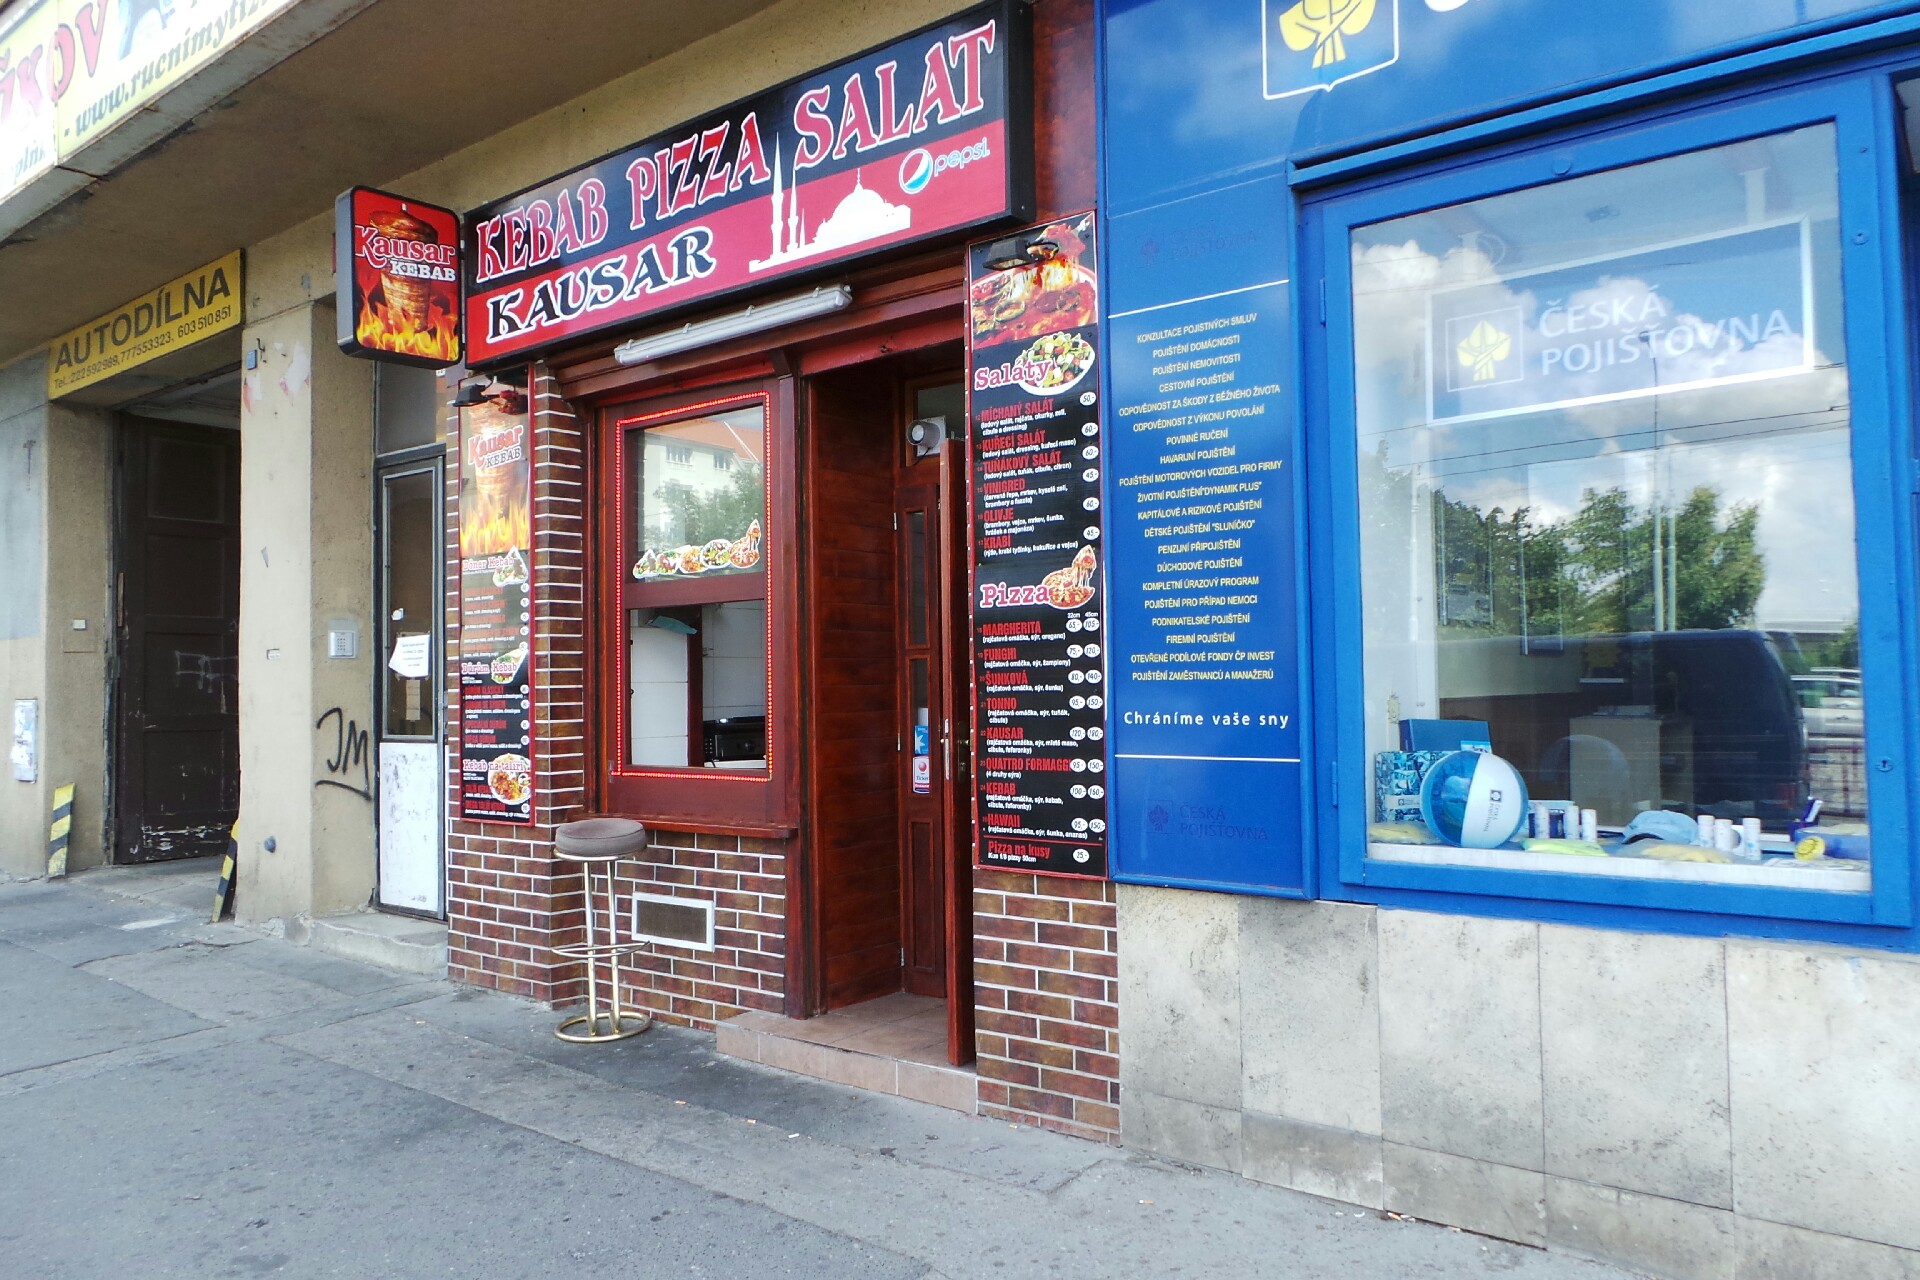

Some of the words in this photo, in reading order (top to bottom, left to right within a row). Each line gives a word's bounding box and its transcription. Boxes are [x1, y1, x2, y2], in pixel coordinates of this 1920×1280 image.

[476, 177, 607, 284] KEBAB
[626, 111, 770, 230] PIZZA
[794, 18, 995, 169] SALAT
[934, 136, 989, 177] pepsi
[355, 225, 455, 269] Kausar
[390, 260, 456, 282] KEBAB
[486, 225, 717, 343] KAUSAR
[54, 267, 231, 374] AUTODÍLNA
[1539, 285, 1667, 339] ČESKÁ
[1137, 326, 1182, 344] KONZULTACE
[1183, 318, 1230, 335] POJISTNÝCH
[1231, 312, 1258, 327] SMLUV
[1152, 342, 1189, 358] POJIŠTĚNÍ
[1190, 334, 1240, 352] DOMÁCNOSTI
[1541, 310, 1792, 376] POJIŠŤOVNA
[1152, 361, 1189, 376] POJIŠTĚNÍ
[1190, 352, 1241, 370] NEMOVITOSTI
[975, 359, 1052, 391] Saláty
[1159, 377, 1196, 393] CESTOVNÍ
[1197, 371, 1235, 387] POJIŠTĚNÍ
[981, 402, 1022, 422] MÍCHANÝ
[1025, 397, 1053, 414] SALÁT
[1119, 400, 1171, 417] ODPOVĚDNOST
[1172, 399, 1182, 410] ZA
[1183, 394, 1208, 408] ŠKODY
[1209, 394, 1215, 403] Z
[1216, 386, 1252, 402] BĚŽNÉHO
[1253, 384, 1281, 398] ŽIVOTA
[1133, 416, 1186, 433] ODPOVĚDNOST
[1187, 416, 1194, 426] Z
[1194, 409, 1225, 424] VÝKONU
[1226, 404, 1265, 418] POVOLÁNÍ
[982, 433, 1014, 451] KUŘECÍ
[1017, 429, 1045, 446] SALÁT
[1166, 431, 1199, 445] POVINNÉ
[1200, 428, 1229, 443] RUČENÍ
[486, 447, 521, 468] KEBAB
[982, 454, 1030, 473] TUŇÁKOVÝ
[1032, 450, 1062, 466] SALÁT
[1197, 445, 1236, 460] POJIŠTĚNÍ
[1119, 472, 1154, 487] POJIŠTĚNÍ
[1155, 467, 1206, 483] MOTOROVÝCH
[1207, 464, 1239, 477] VOZIDEL
[1240, 463, 1257, 474] PRO
[1258, 460, 1282, 472] FIRMY
[984, 478, 1025, 494] VINIGRED
[1137, 489, 1165, 503] ŽIVOTNÍ
[984, 508, 1014, 523] OLIVJE
[1138, 506, 1181, 520] KAPITÁLOVÉ
[1182, 507, 1188, 516] A
[1188, 503, 1222, 516] RIZIKOVÉ
[1223, 499, 1262, 513] POJIŠTĚNÍ
[1144, 525, 1172, 538] DĚTSKÉ
[1173, 522, 1210, 535] POJIŠTĚNÍ
[1191, 538, 1241, 551] PŘIPOJIŠTĚNÍ
[1157, 560, 1203, 573] DŮCHODOVÉ
[1204, 556, 1242, 569] POJIŠTĚNÍ
[1142, 580, 1183, 591] KOMPLETNÍ
[1184, 577, 1219, 589] ÚRAZOVÝ
[1220, 576, 1259, 587] PROGRAM
[979, 580, 1051, 608] Pizza
[1144, 597, 1181, 609] POJIŠTĚNÍ
[1182, 598, 1198, 607] PRO
[1199, 594, 1226, 606] PŘÍPAD
[1227, 595, 1258, 605] NEMOCI
[982, 621, 1041, 636] MARGHERITA
[1152, 614, 1210, 626] PODNIKATELSKÉ
[1211, 612, 1250, 624] POJIŠTĚNÍ
[1166, 632, 1196, 644] FIREMNÍ
[1197, 631, 1235, 643] POJIŠTĚNÍ
[984, 647, 1017, 660] FUNGHI
[1131, 652, 1168, 663] OTEVŘENÉ
[1169, 651, 1206, 662] PODÍLOVÉ
[1207, 652, 1234, 661] FONDY
[1247, 651, 1275, 661] INVEST
[985, 670, 1028, 685] ŠUNKOVÁ
[1132, 670, 1168, 681] POJIŠTĚNÍ
[1169, 669, 1224, 681] ZAMĚSTNANCŮ
[1231, 667, 1274, 680] MANAŽERŮ
[987, 698, 1017, 709] TONNO
[1123, 711, 1204, 726] Chráníme
[1212, 711, 1251, 727] vaše
[1259, 714, 1290, 730] sny
[987, 727, 1024, 739] KAUSAR
[986, 757, 1022, 770] QUATTRO
[986, 783, 1016, 795] KEBAB
[988, 813, 1020, 827] HAWAII
[988, 840, 1012, 854] Pizza
[1014, 845, 1026, 855] na
[1029, 844, 1050, 859] kusy
